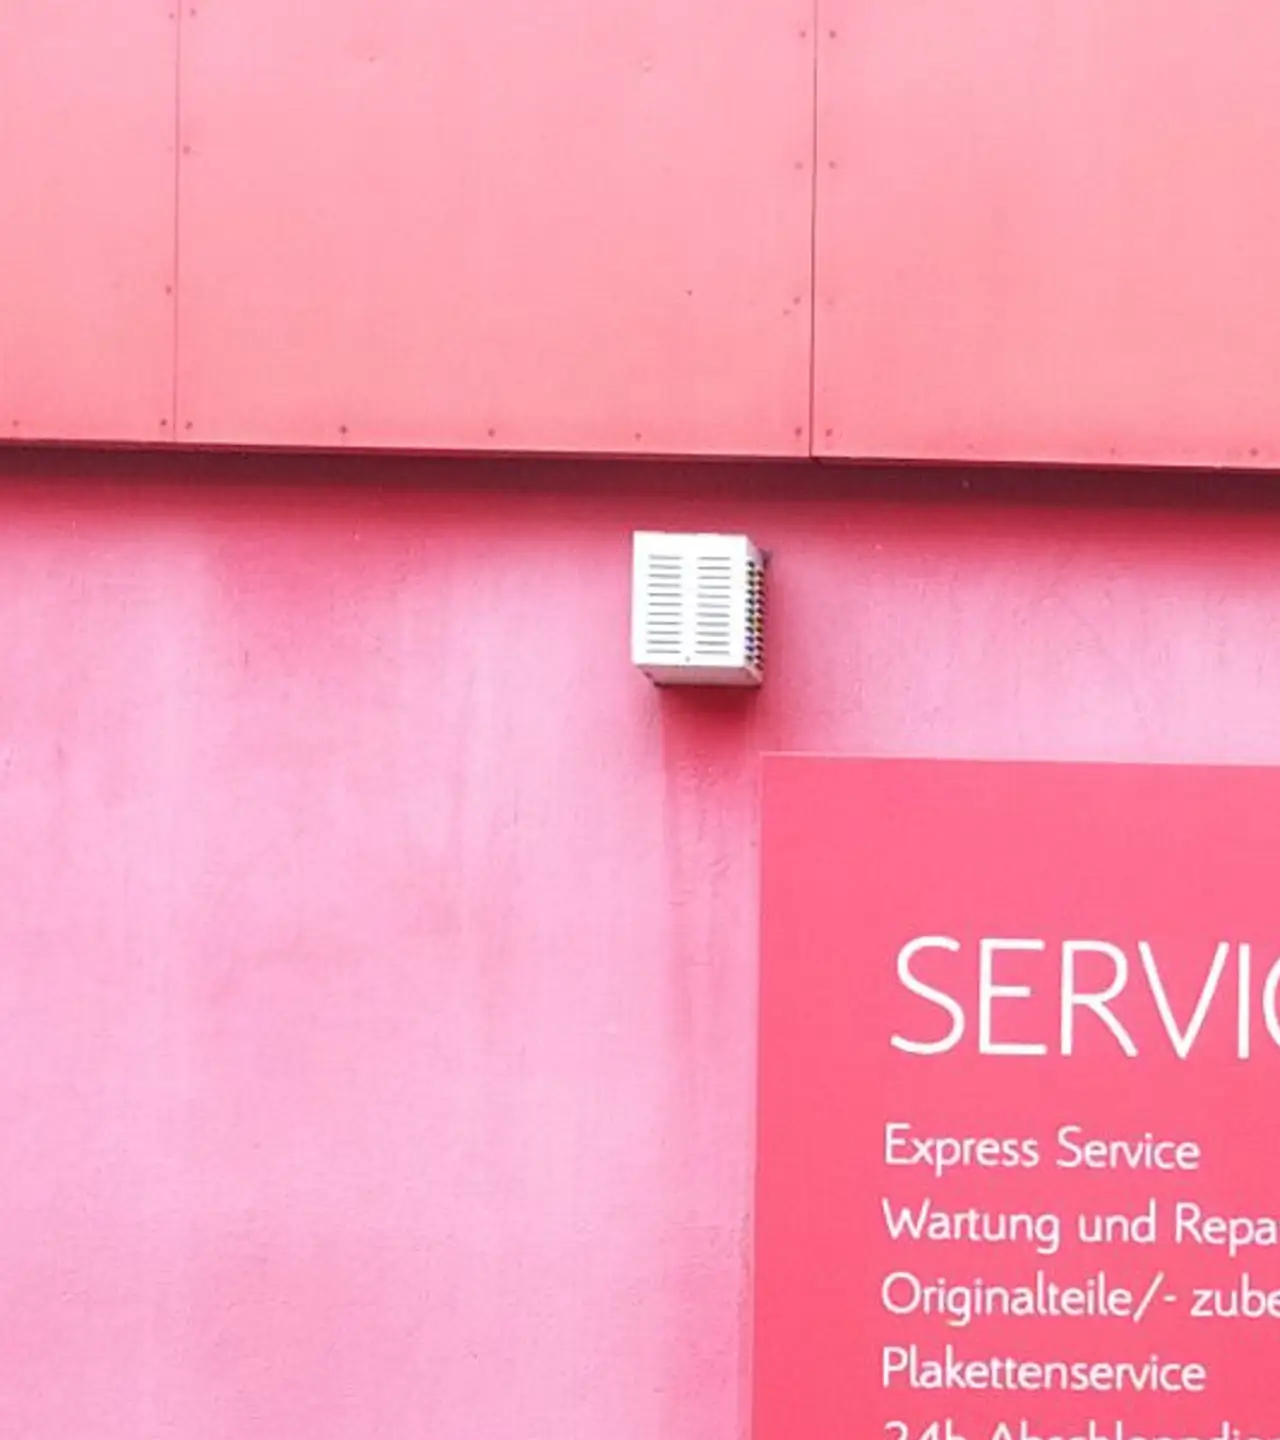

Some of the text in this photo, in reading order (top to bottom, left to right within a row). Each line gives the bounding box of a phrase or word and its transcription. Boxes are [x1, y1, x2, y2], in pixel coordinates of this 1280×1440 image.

[885, 1122, 1200, 1177] Express Service
[882, 1198, 1060, 1255] Wartung
[1078, 1198, 1156, 1243] und
[882, 1344, 1206, 1391] Plakettenservice
